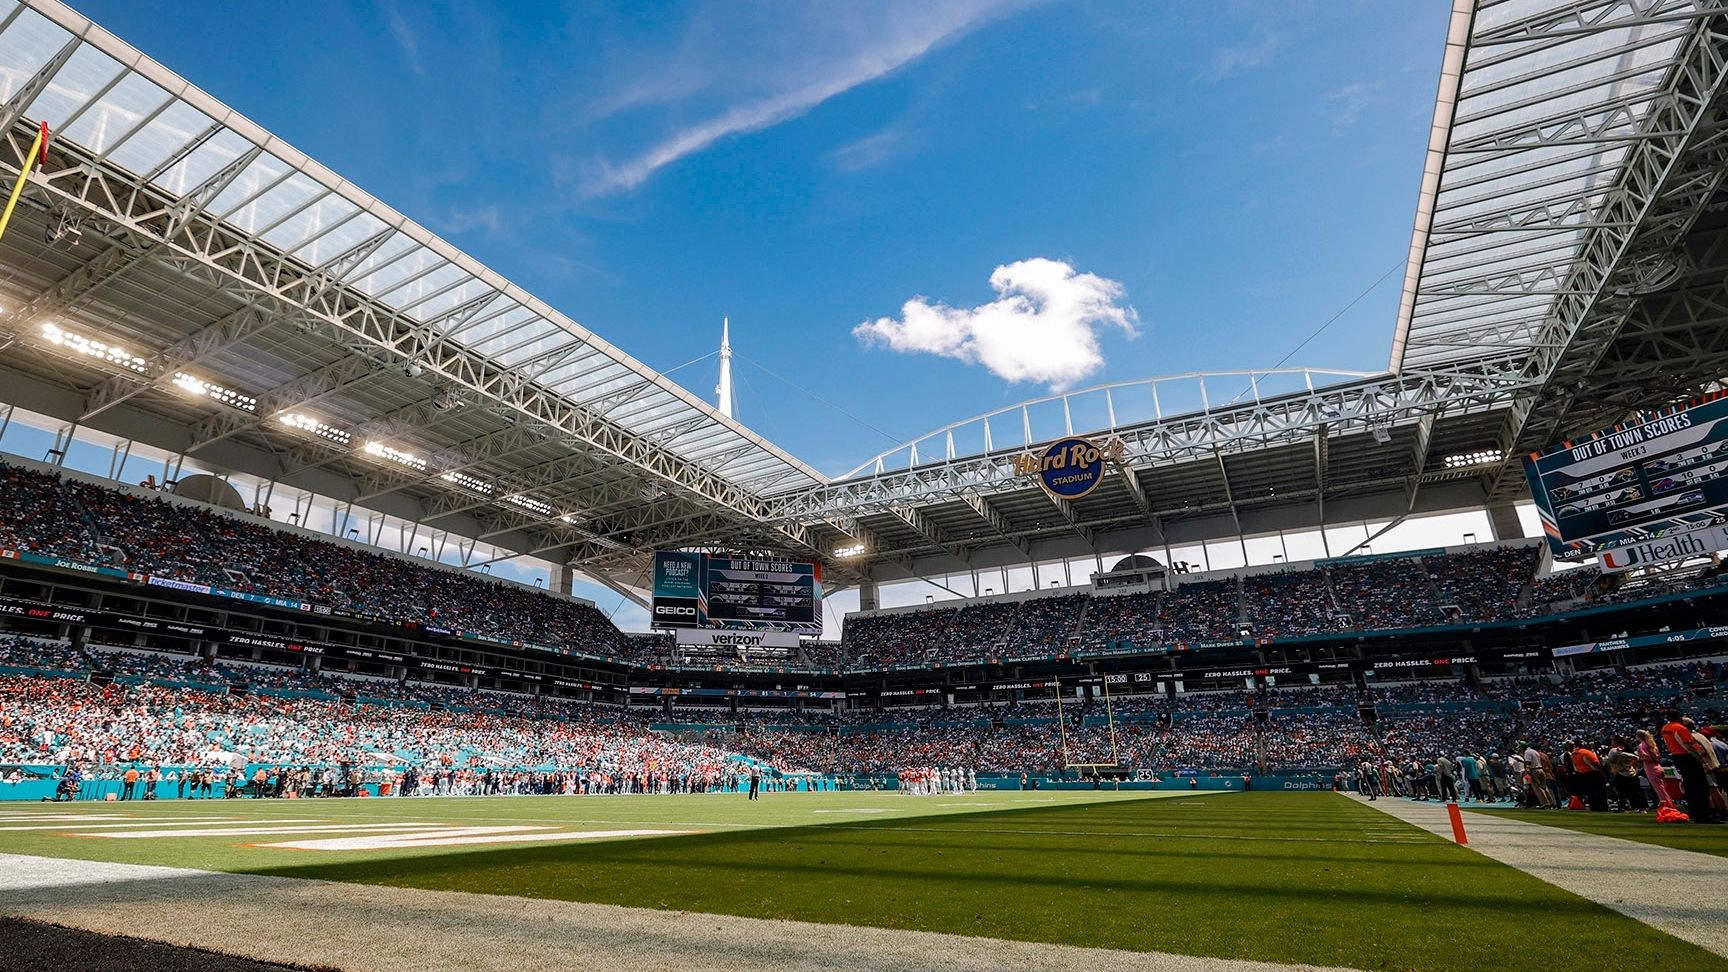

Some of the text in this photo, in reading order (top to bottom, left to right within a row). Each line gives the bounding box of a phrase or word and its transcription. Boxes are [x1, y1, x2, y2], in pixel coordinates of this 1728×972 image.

[1572, 412, 1692, 462] OUT OF TOWN SCORES
[1014, 435, 1126, 476] Hard Rock
[1620, 445, 1647, 460] WEEK 3
[1677, 453, 1683, 461] 3
[1052, 472, 1093, 486] STADIUM
[1682, 471, 1694, 479] 10
[1685, 521, 1706, 530] 15:00
[1715, 516, 1726, 524] 25
[1619, 533, 1654, 546] MIA 14
[1564, 549, 1581, 558] DEN
[55, 560, 98, 573] JOE ROBBIE
[663, 561, 676, 569] NEED
[681, 562, 692, 570] NEW
[730, 560, 793, 573] OUT OF TOWN SCORES
[665, 569, 690, 577] PODCAST?
[231, 592, 244, 600] DEN
[28, 609, 51, 617] ONE
[53, 612, 85, 622] PRICE.
[656, 606, 696, 615] GEICO
[229, 636, 250, 644] ZERO
[251, 639, 287, 649] HASSLES.
[303, 646, 325, 654] PRICE.
[712, 633, 760, 646] verizon
[1600, 644, 1631, 652] SEAHAWKS
[435, 664, 459, 672] HASSLES.
[471, 668, 487, 676] PRICE.
[1107, 675, 1127, 683] 15:00
[1138, 673, 1148, 681] 25
[1139, 770, 1152, 780] 25
